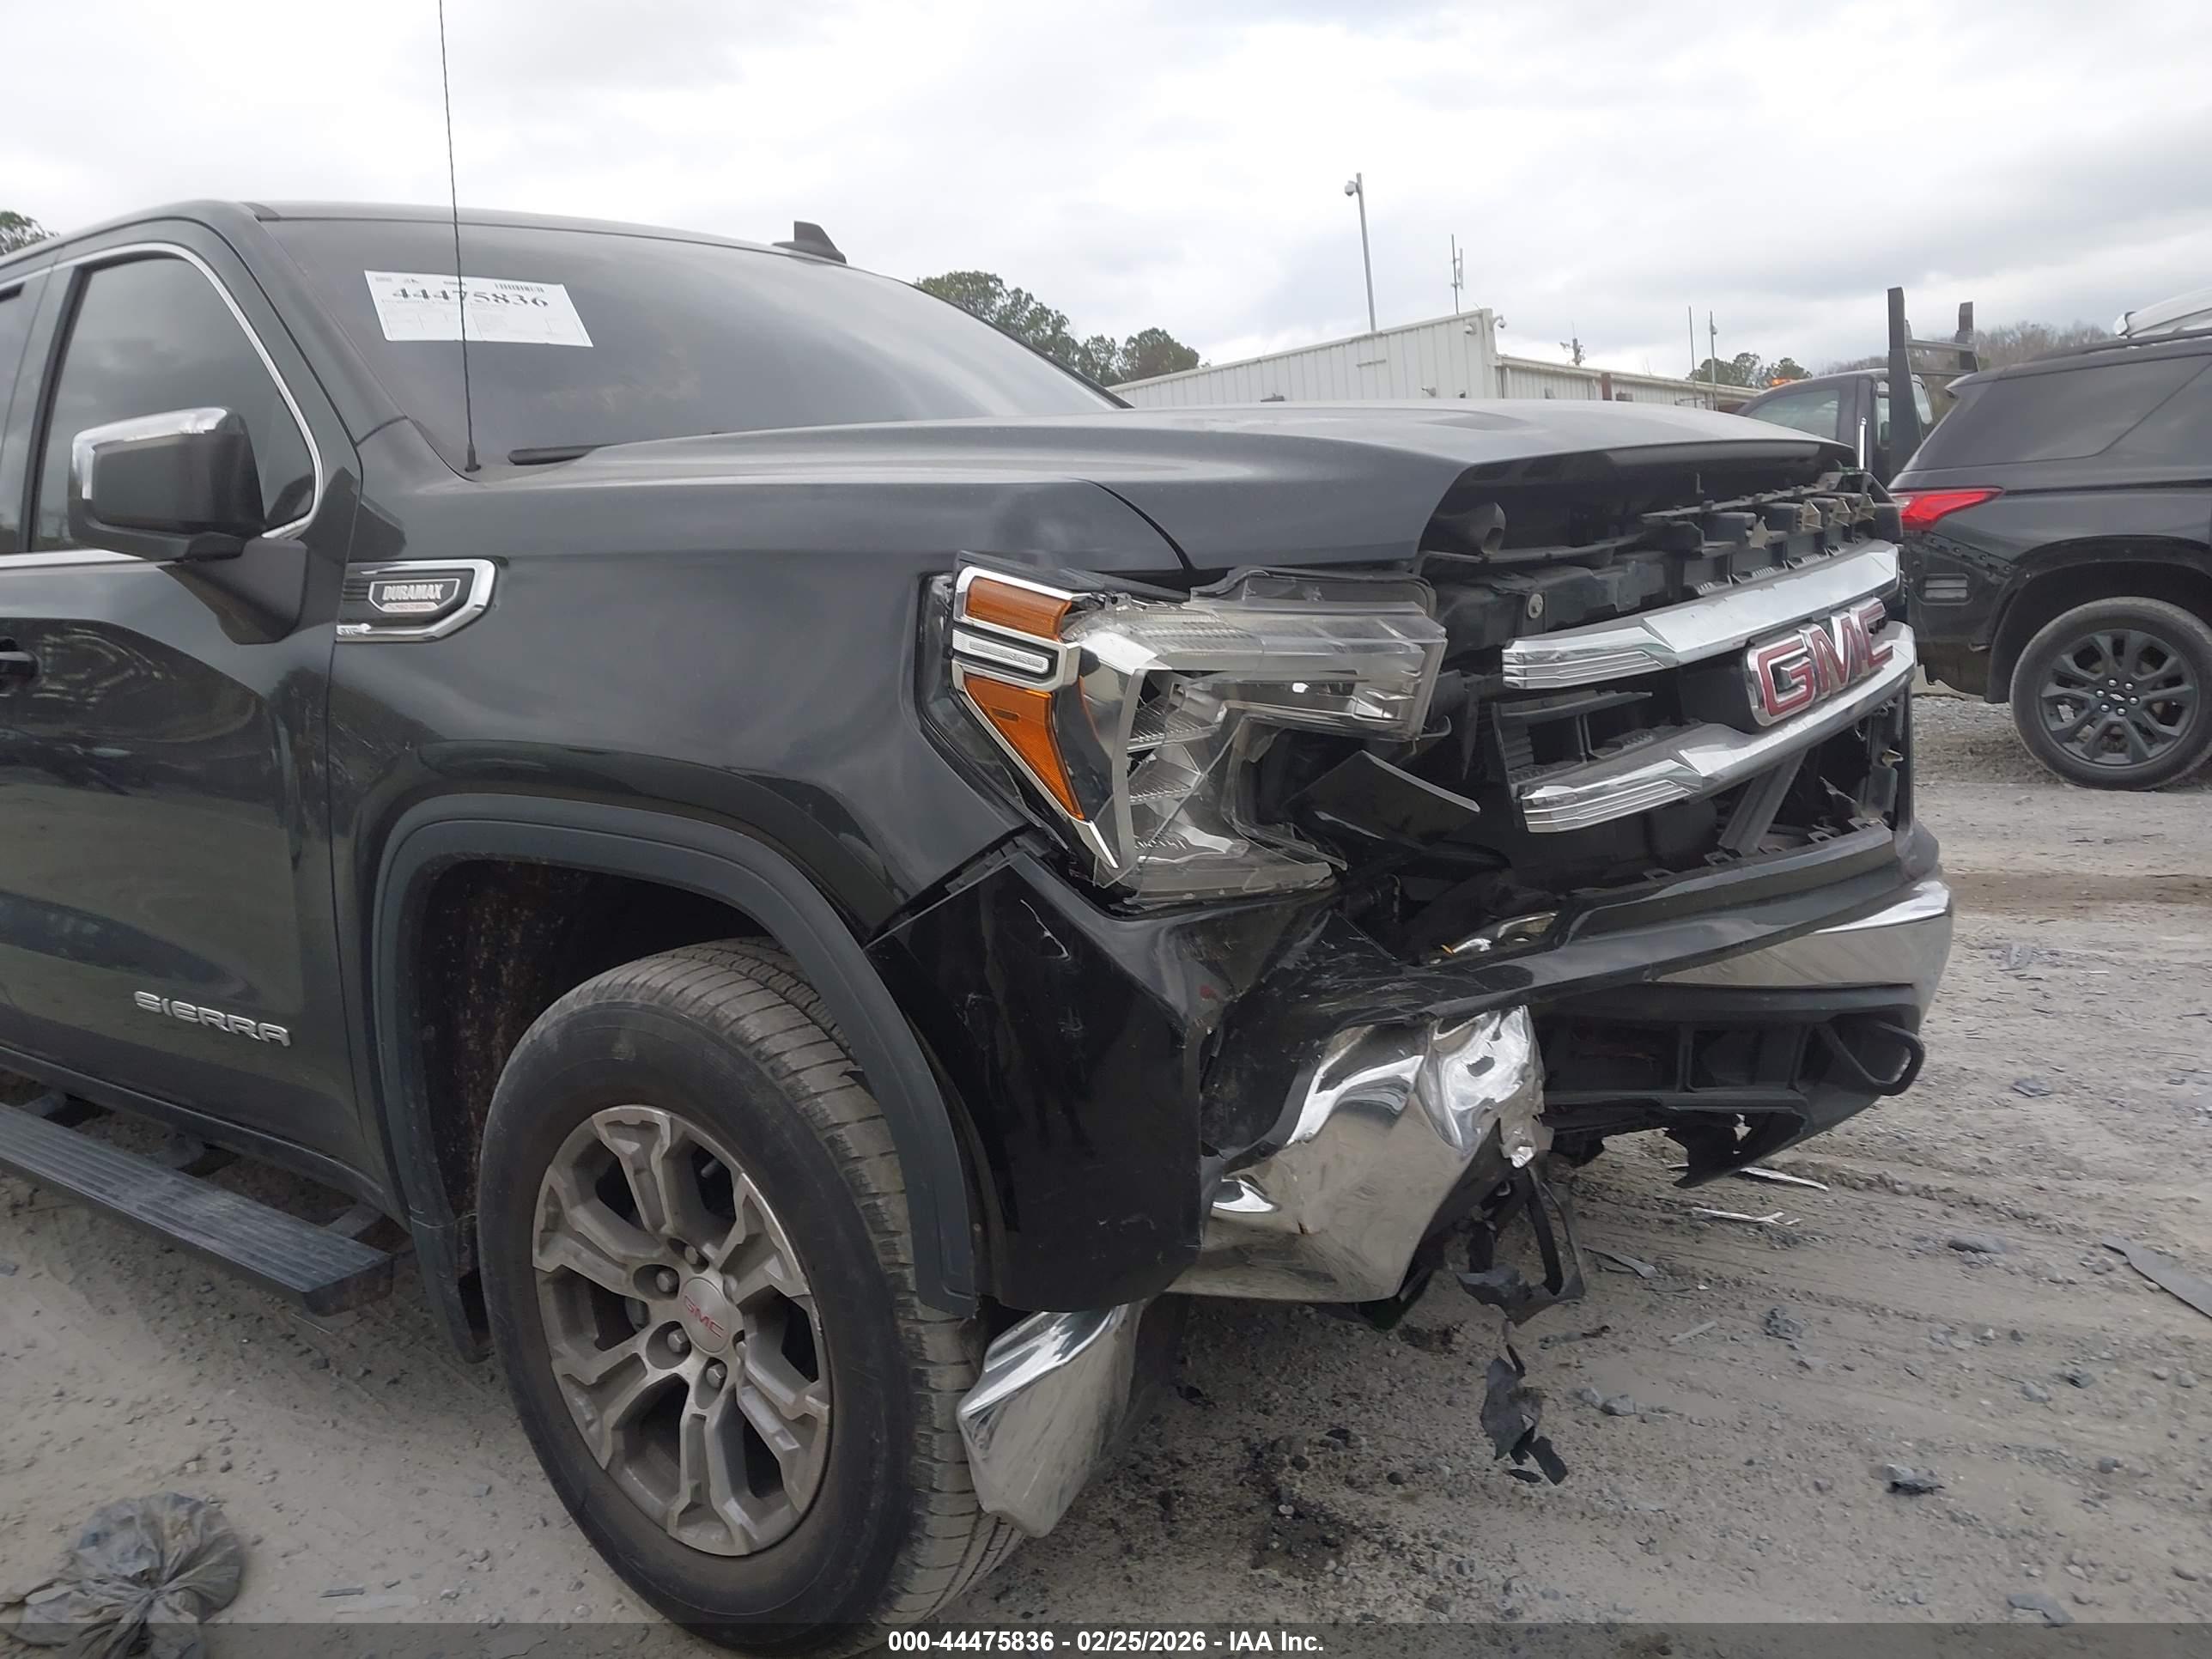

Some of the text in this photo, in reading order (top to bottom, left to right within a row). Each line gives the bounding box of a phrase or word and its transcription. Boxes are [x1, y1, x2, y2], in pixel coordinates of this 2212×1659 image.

[392, 288, 549, 307] 44475836
[382, 584, 444, 600] DURAMAX
[1747, 598, 1893, 726] GMC
[134, 990, 290, 1047] SIERRA
[684, 1295, 724, 1339] GMC
